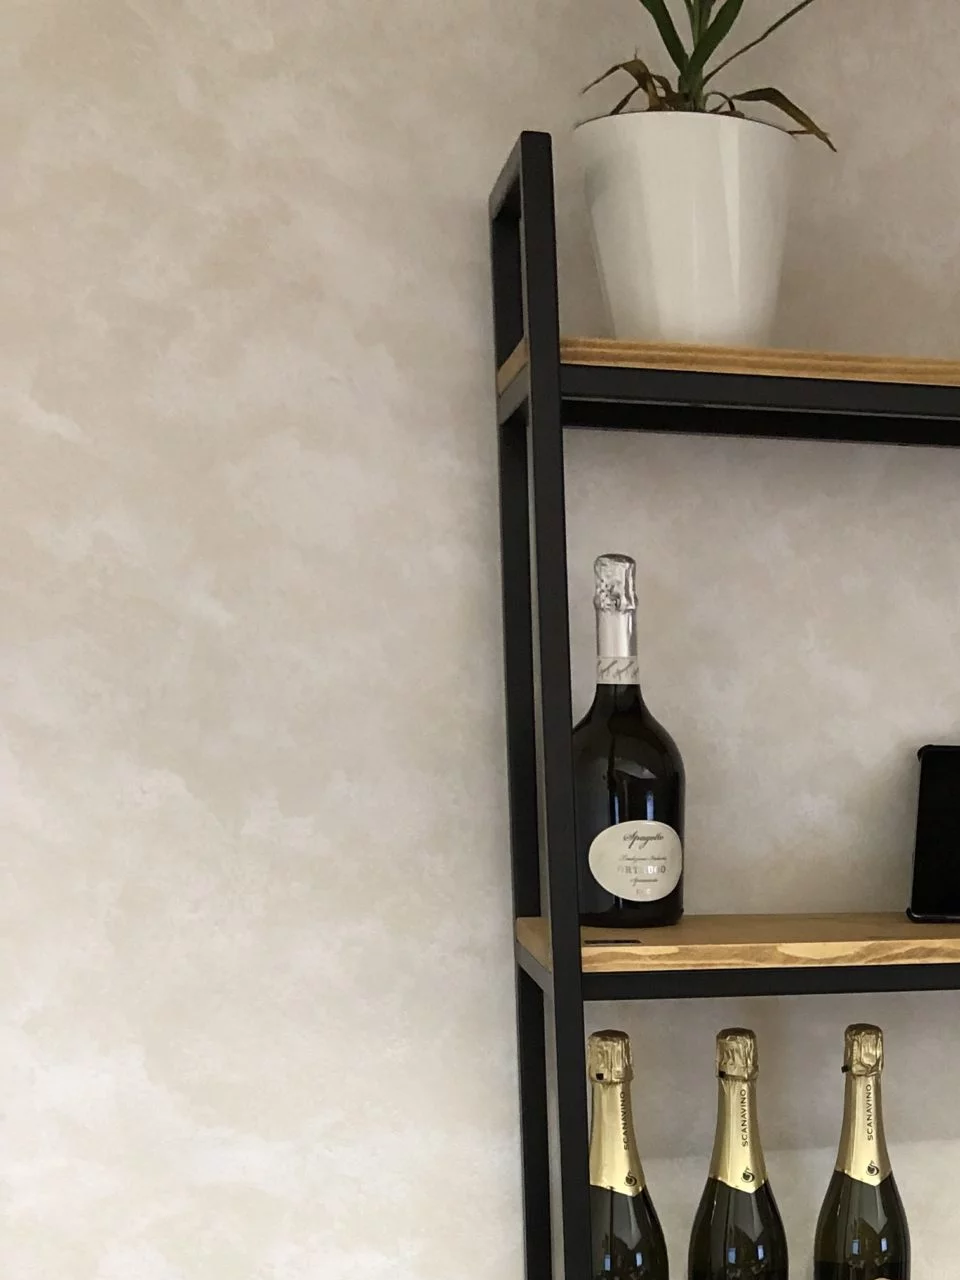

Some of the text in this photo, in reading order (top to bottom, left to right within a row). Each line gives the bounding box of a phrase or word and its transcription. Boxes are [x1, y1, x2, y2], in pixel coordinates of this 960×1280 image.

[619, 1090, 630, 1151] SCANAVINO
[739, 1088, 749, 1148] SCANAVINO
[865, 1083, 874, 1142] SCANAVINO
